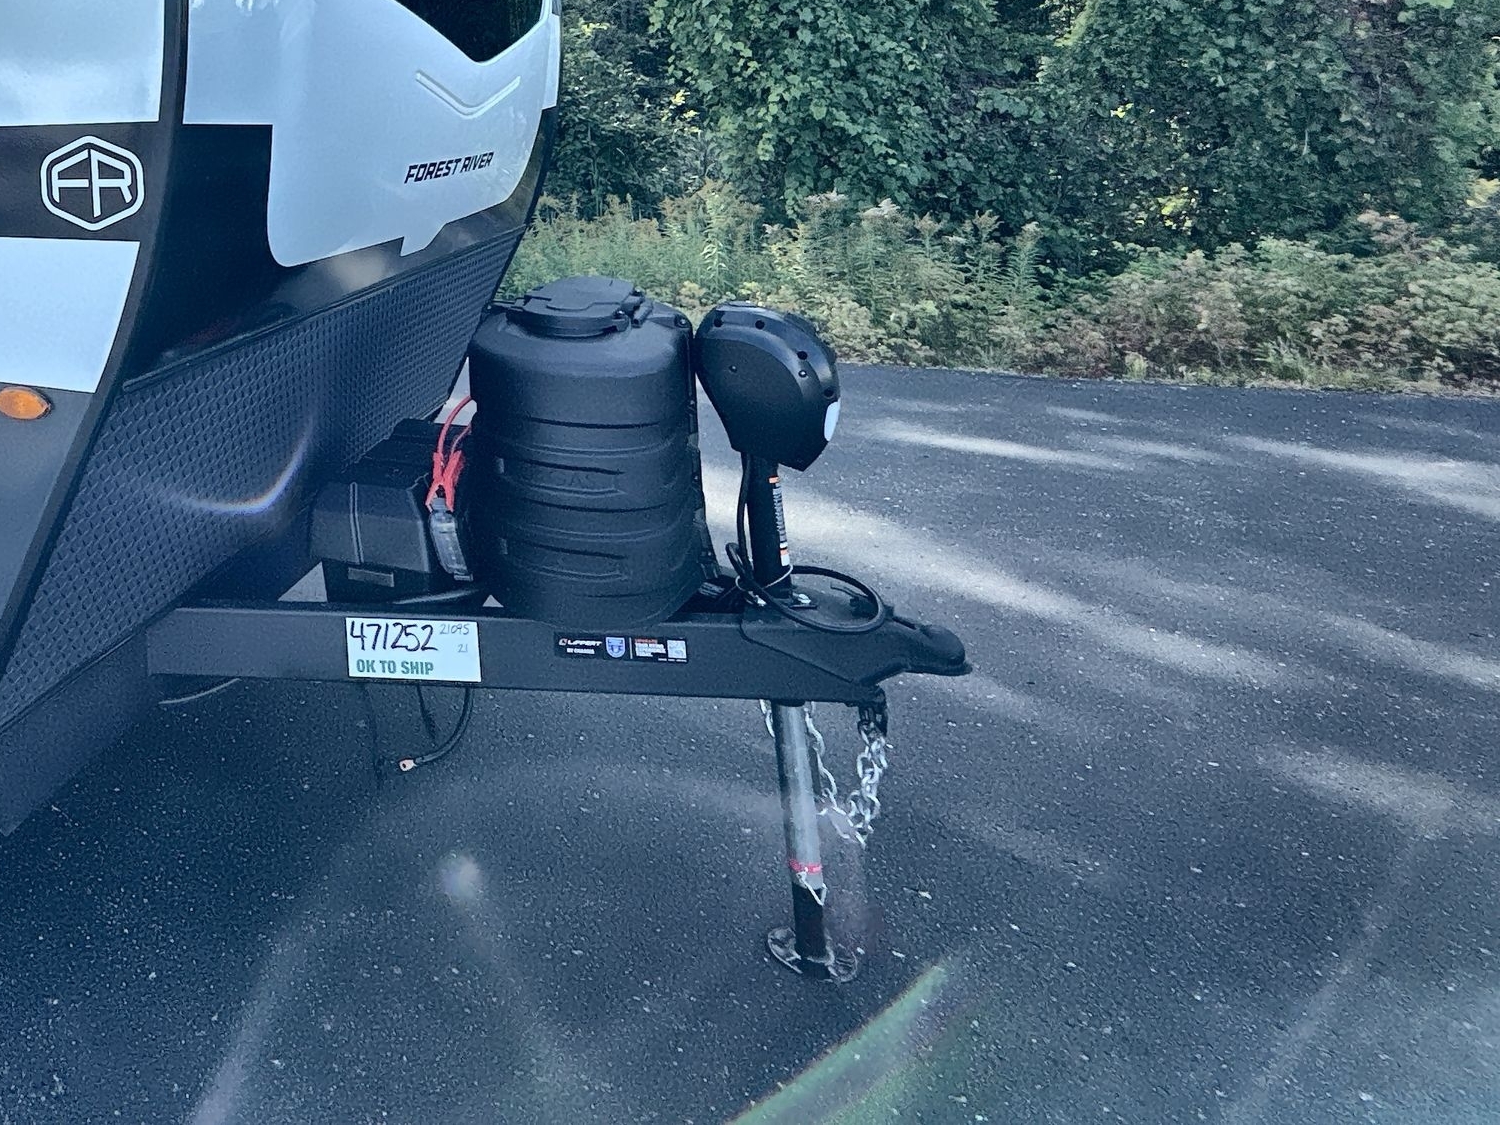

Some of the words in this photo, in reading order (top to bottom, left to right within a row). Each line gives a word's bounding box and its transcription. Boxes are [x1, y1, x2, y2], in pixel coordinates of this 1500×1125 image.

[403, 158, 462, 184] FOREST
[460, 151, 495, 174] RIVER
[350, 620, 438, 652] 471252
[356, 659, 376, 673] OK
[379, 660, 396, 674] TO
[401, 661, 434, 675] SHIP
